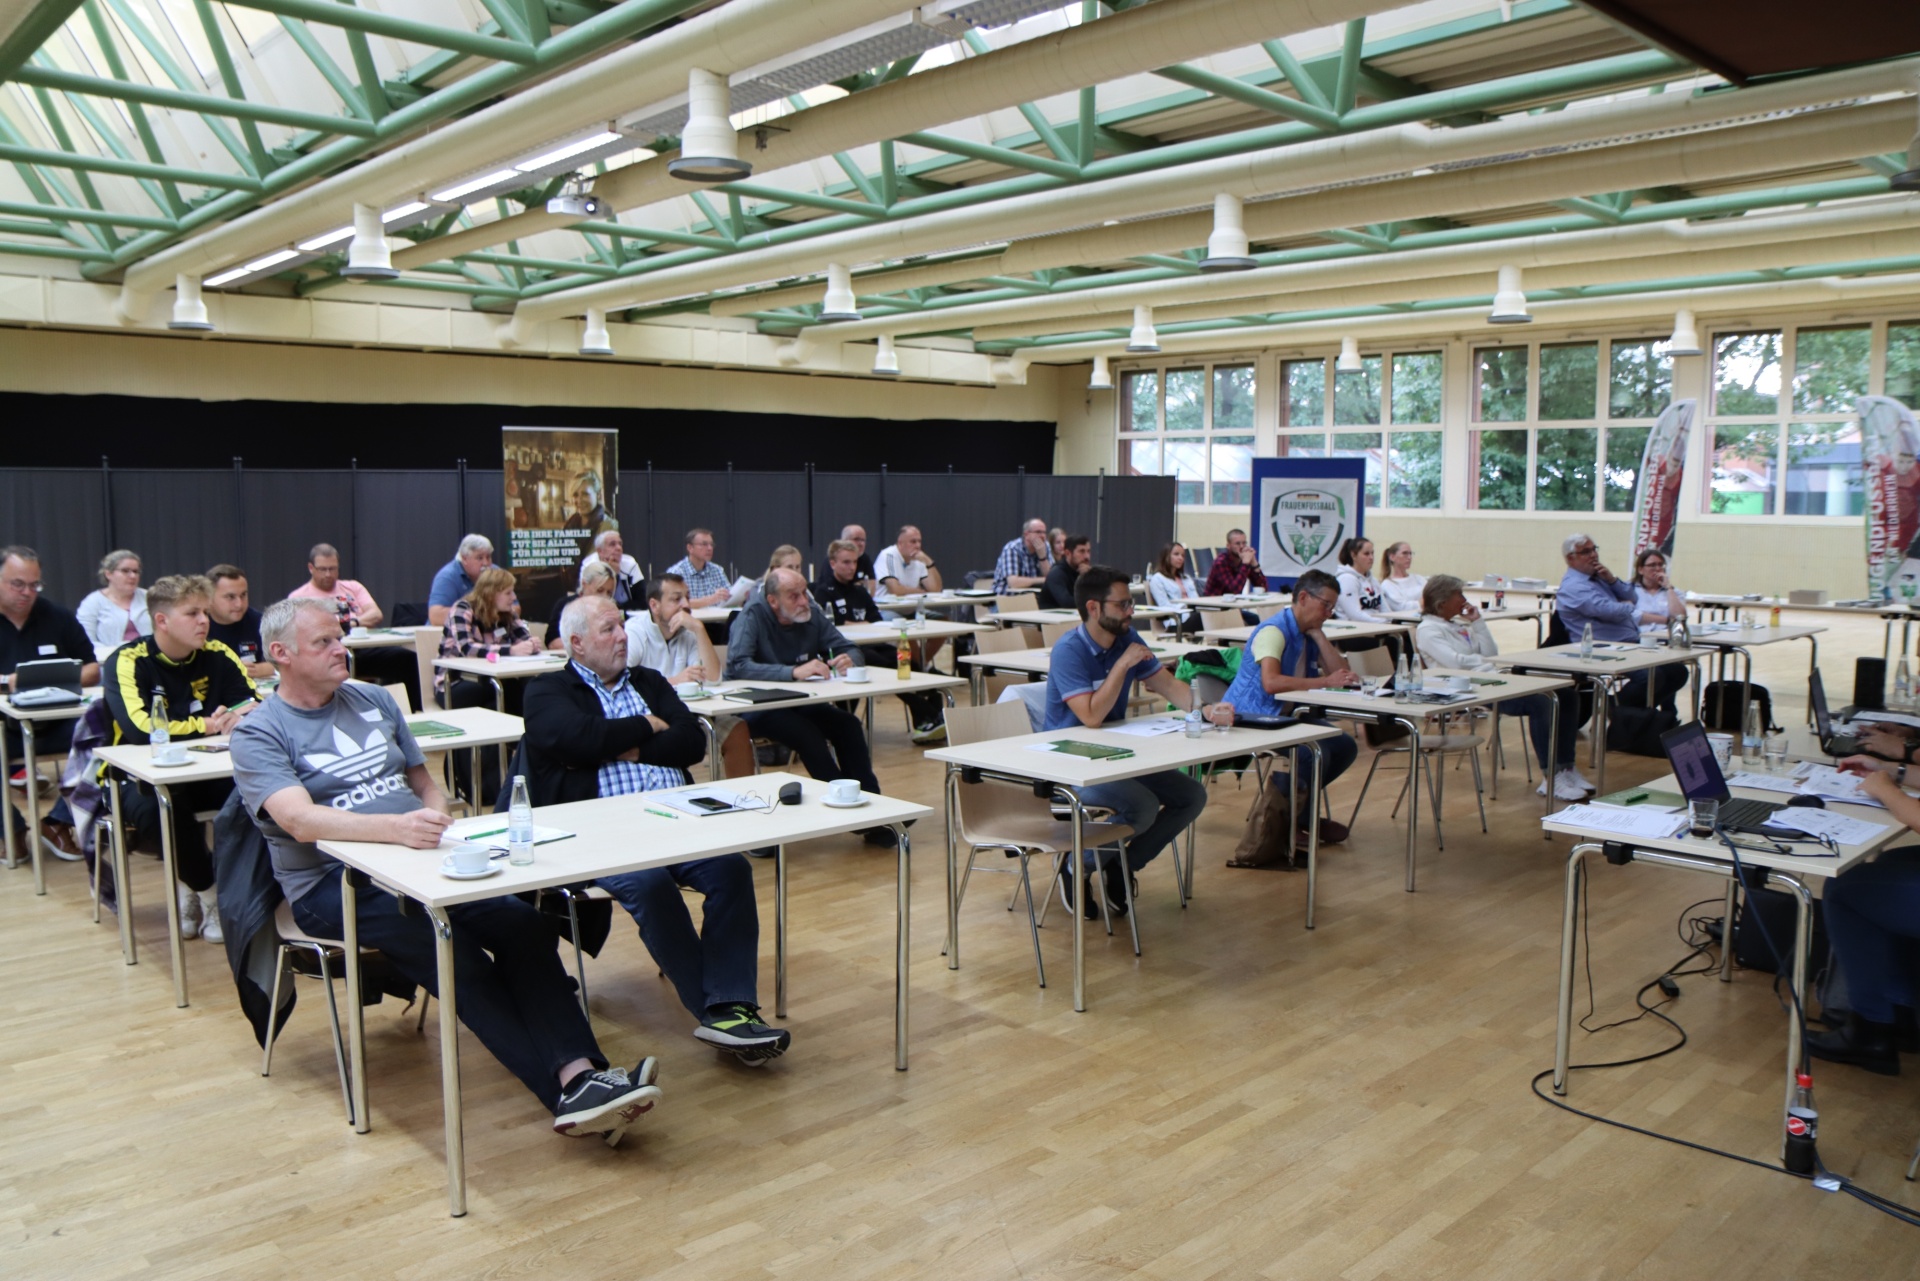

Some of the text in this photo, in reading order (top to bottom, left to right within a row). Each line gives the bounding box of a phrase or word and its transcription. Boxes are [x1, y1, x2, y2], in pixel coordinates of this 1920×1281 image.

[1281, 501, 1336, 511] FRAUENFUSSBALL
[1651, 474, 1666, 537] NIEDERRHEIN
[1884, 474, 1901, 564] AM NIEDERRHEIN
[511, 529, 591, 539] FÜR IHRE FAMILIE
[512, 539, 577, 549] TUT SIE ALLES.
[512, 548, 581, 558] FÜR MANN UND
[512, 557, 574, 567] KINDER AUCH.
[332, 773, 407, 811] adidas
